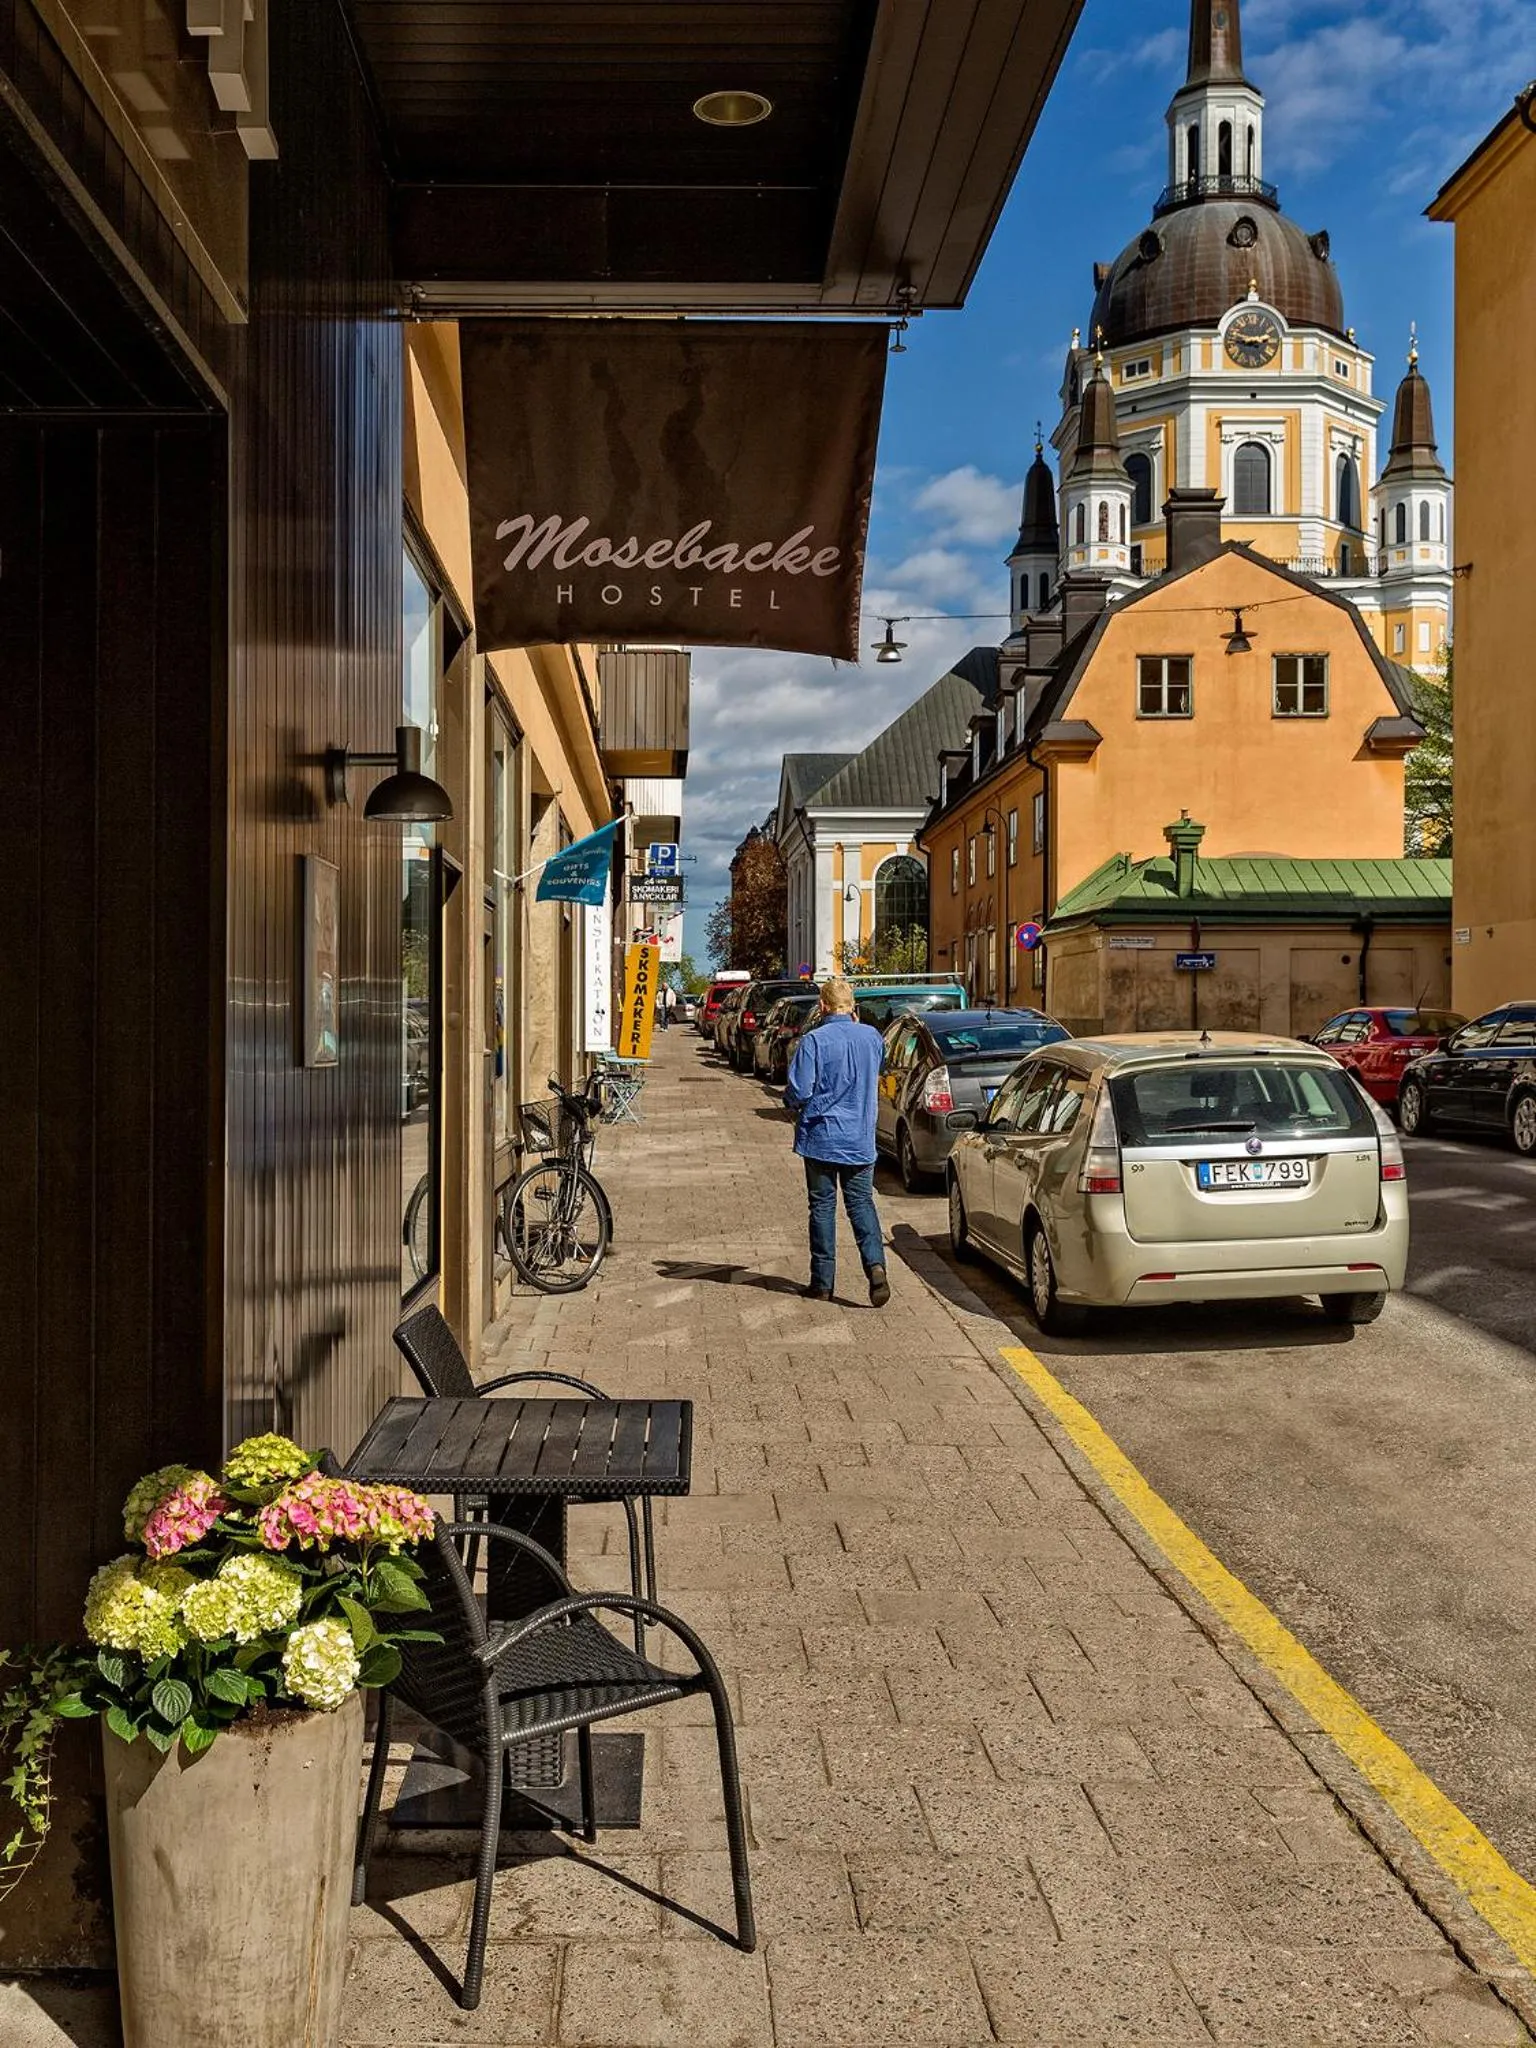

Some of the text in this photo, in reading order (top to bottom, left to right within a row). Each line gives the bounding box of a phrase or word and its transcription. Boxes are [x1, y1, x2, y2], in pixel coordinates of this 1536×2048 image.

[495, 513, 841, 577] Mosebacke
[557, 585, 781, 610] HOSTEL
[658, 846, 671, 865] P
[547, 878, 601, 887] SOUVENIRS
[632, 885, 680, 894] SKOMAKERI
[631, 947, 650, 1055] SKOMAKERI
[1212, 1161, 1304, 1183] FEK 799
